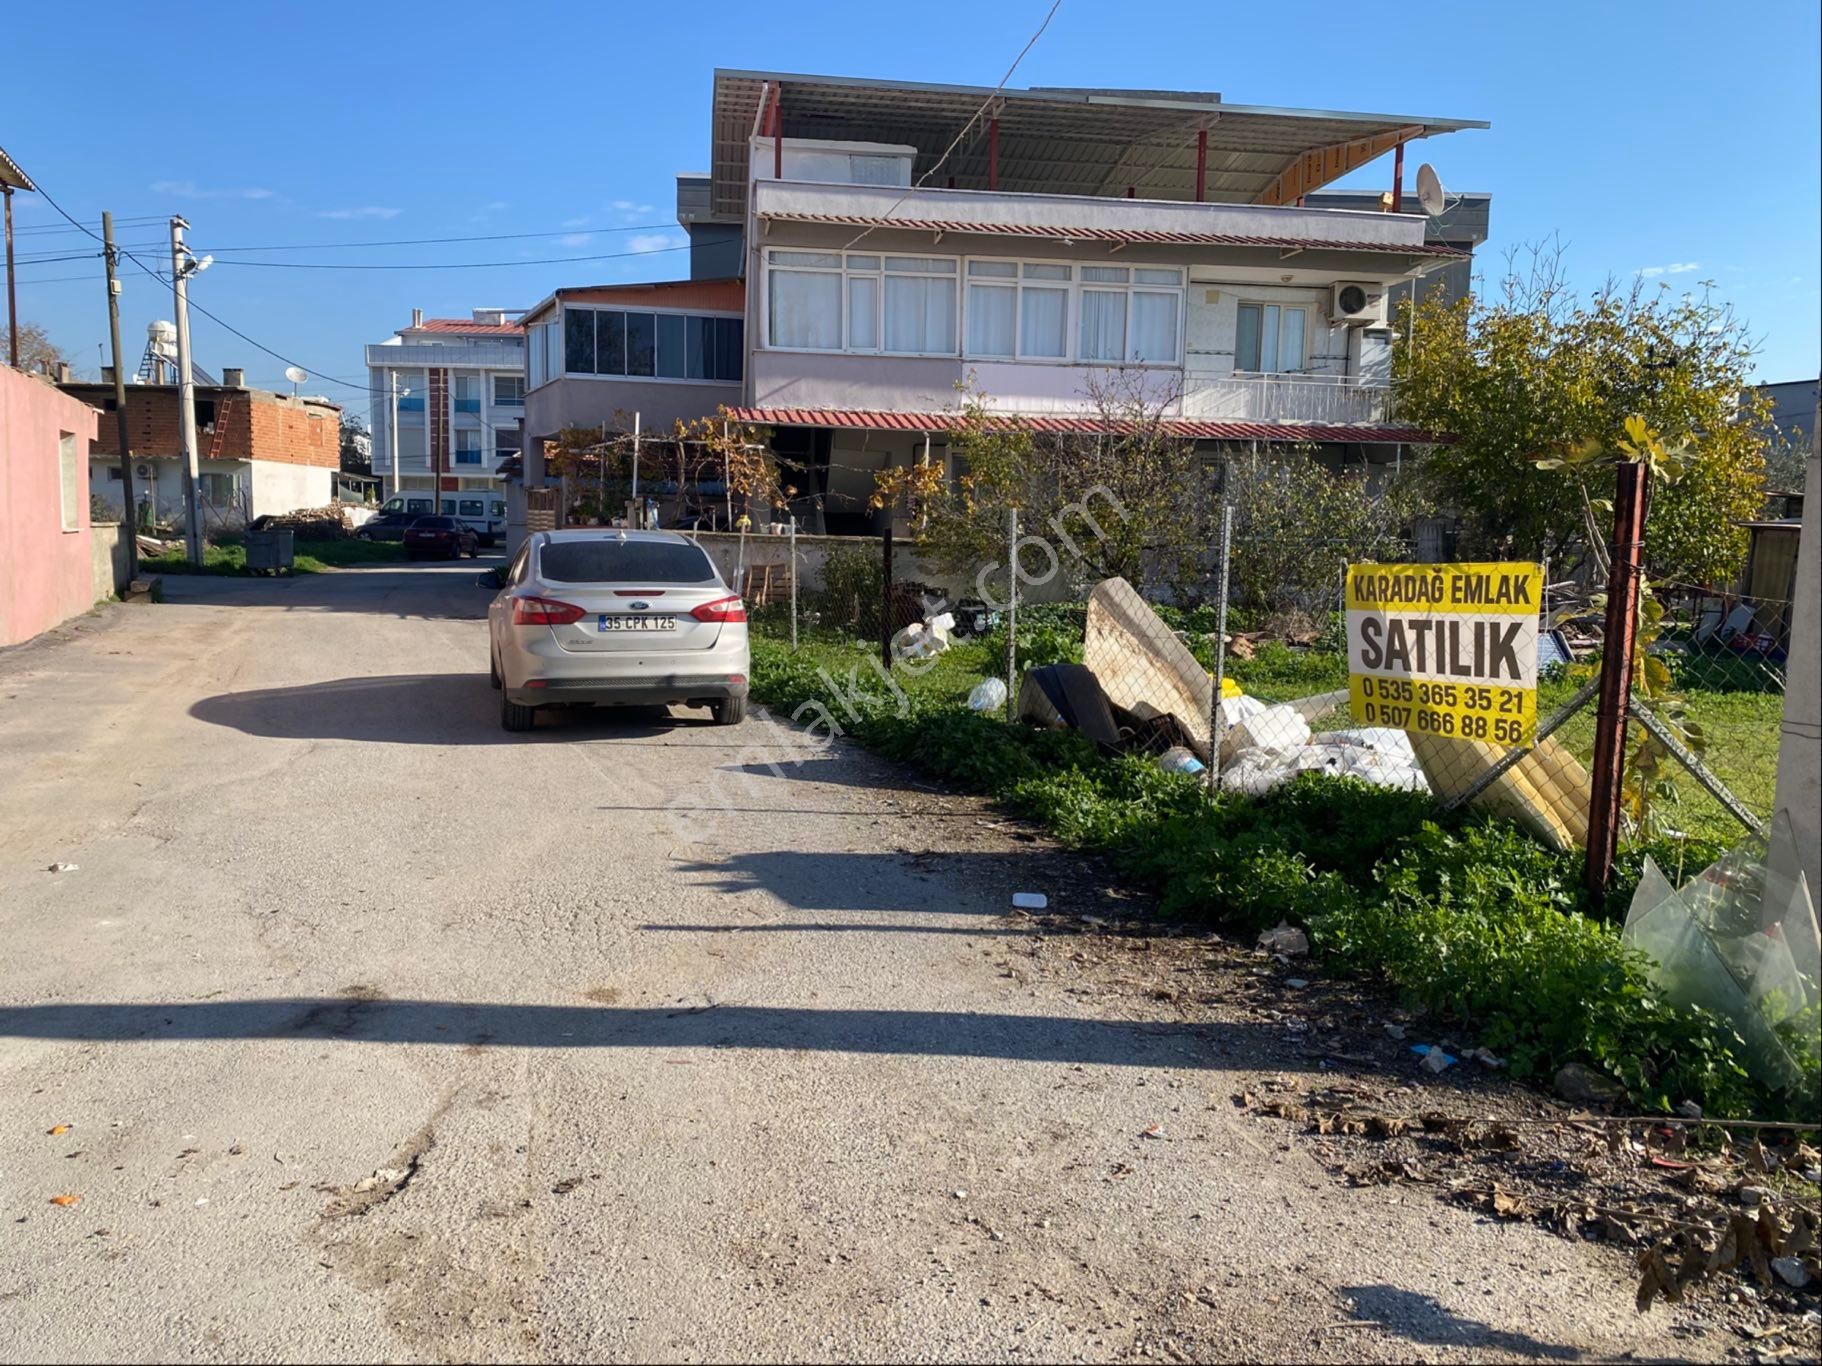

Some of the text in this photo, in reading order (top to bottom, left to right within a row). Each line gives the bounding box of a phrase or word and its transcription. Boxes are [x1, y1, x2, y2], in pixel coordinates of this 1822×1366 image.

[1354, 568, 1530, 604] KARADAĞ EMLAK
[606, 616, 621, 629] 35
[625, 616, 648, 629] CPK
[653, 616, 675, 629] 125
[1360, 616, 1523, 680] SATILIK
[1363, 677, 1523, 714] 0 535 365 35 21
[1365, 702, 1522, 744] 0 507 666 88 56
